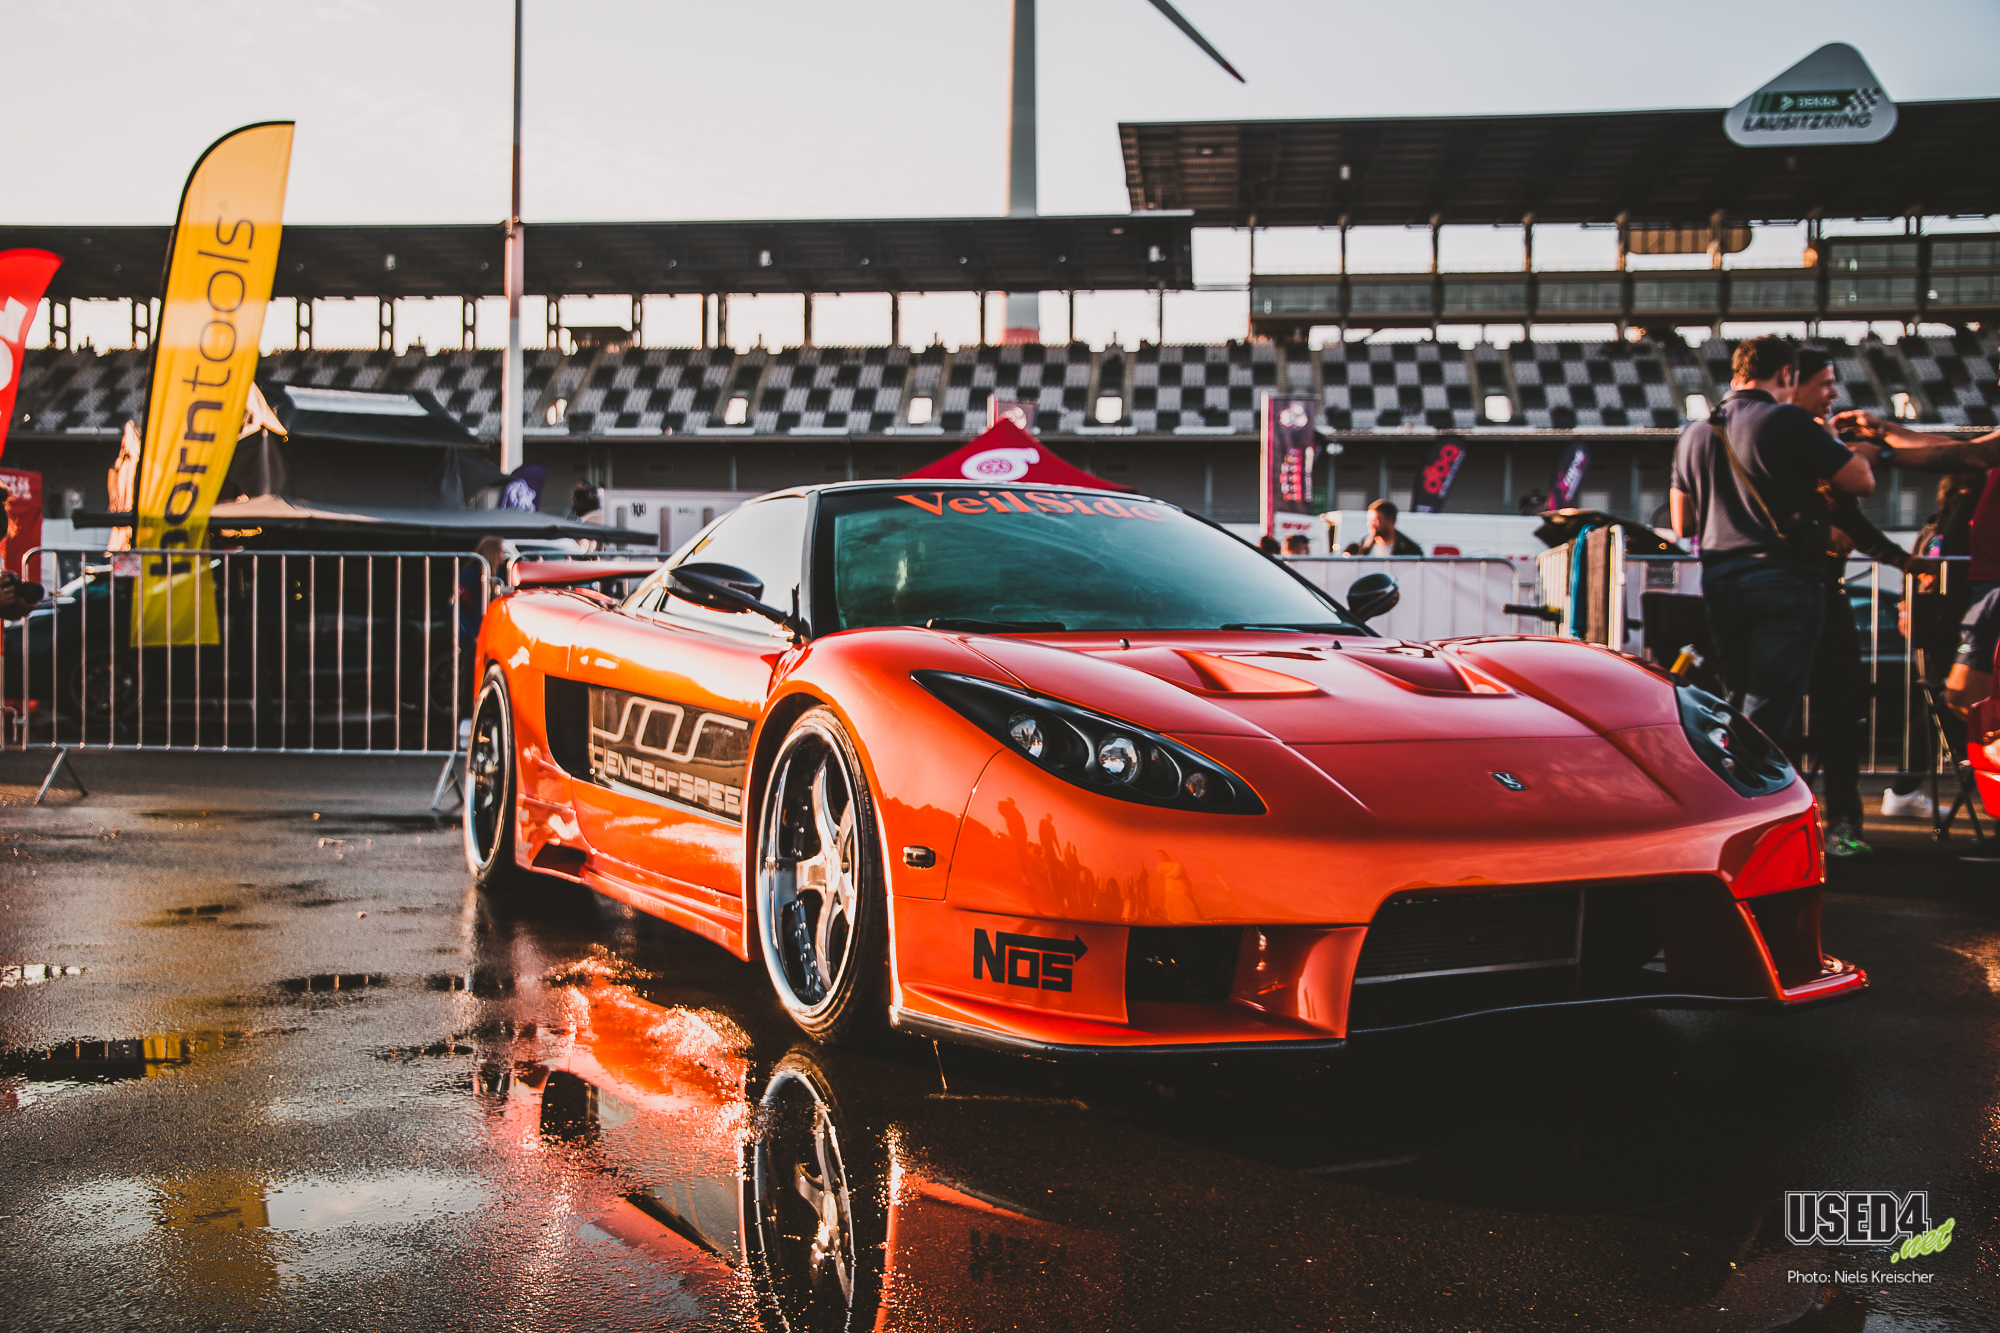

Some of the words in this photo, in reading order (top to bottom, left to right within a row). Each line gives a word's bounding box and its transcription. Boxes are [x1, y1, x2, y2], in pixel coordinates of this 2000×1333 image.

[1742, 112, 1872, 132] LAUSITZRING
[894, 490, 1166, 522] VeilSide
[973, 928, 1073, 993] NOS
